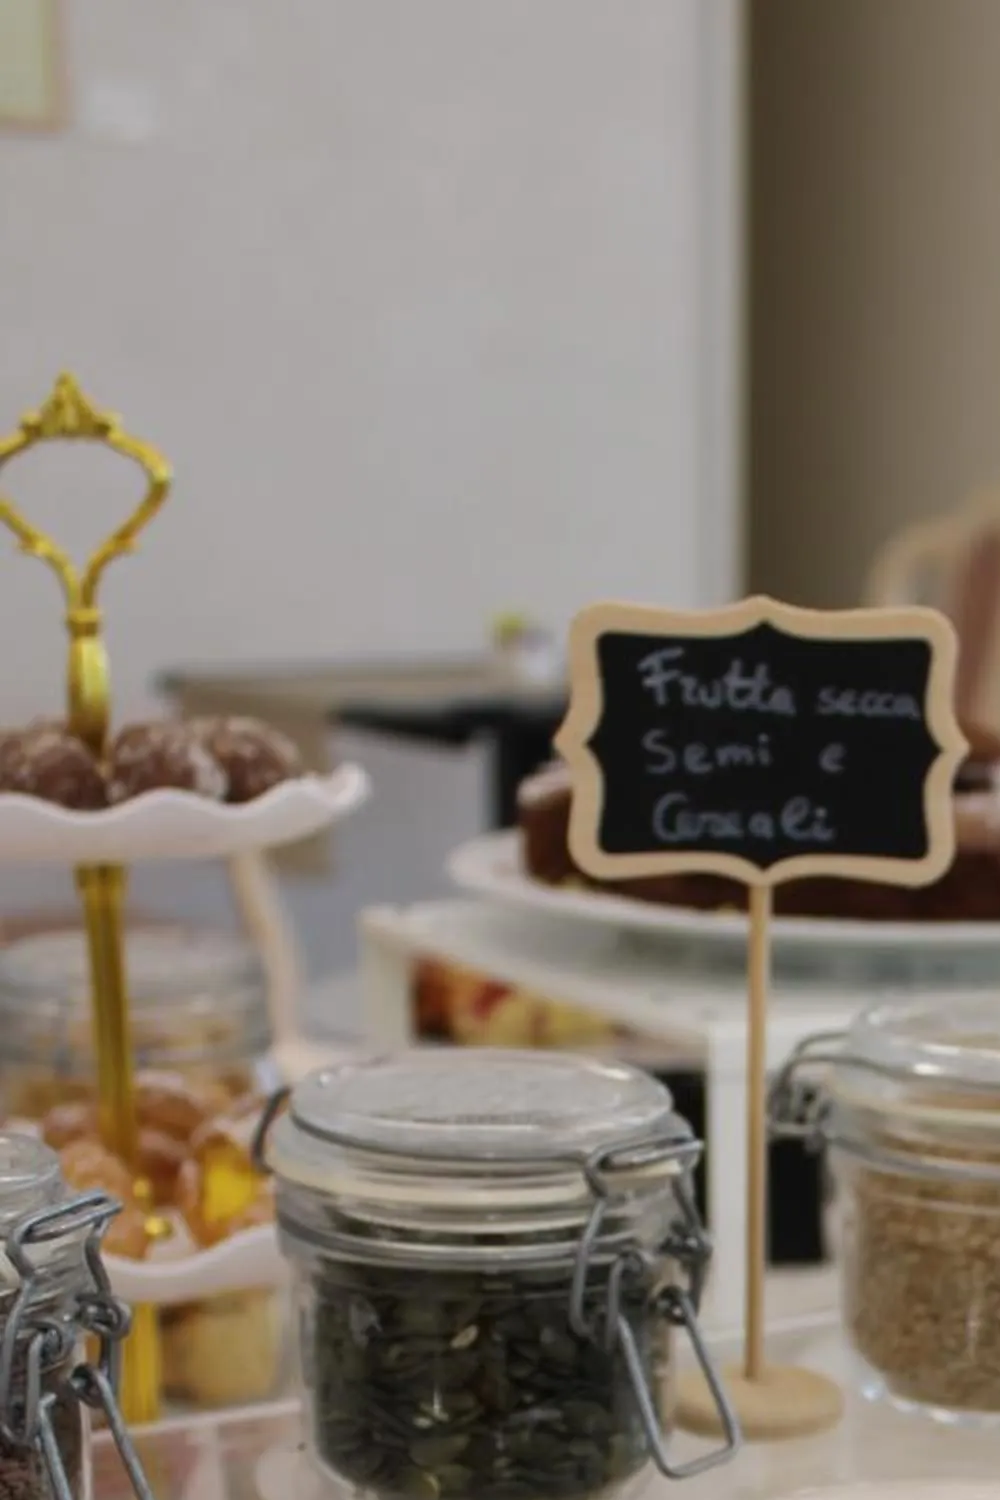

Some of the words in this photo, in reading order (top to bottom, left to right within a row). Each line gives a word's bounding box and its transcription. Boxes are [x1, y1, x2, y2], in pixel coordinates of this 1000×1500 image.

[637, 647, 796, 716] Frutta
[817, 691, 920, 719] secca
[642, 729, 772, 774] Semi
[819, 743, 846, 772] e
[652, 792, 836, 842] Cereali
